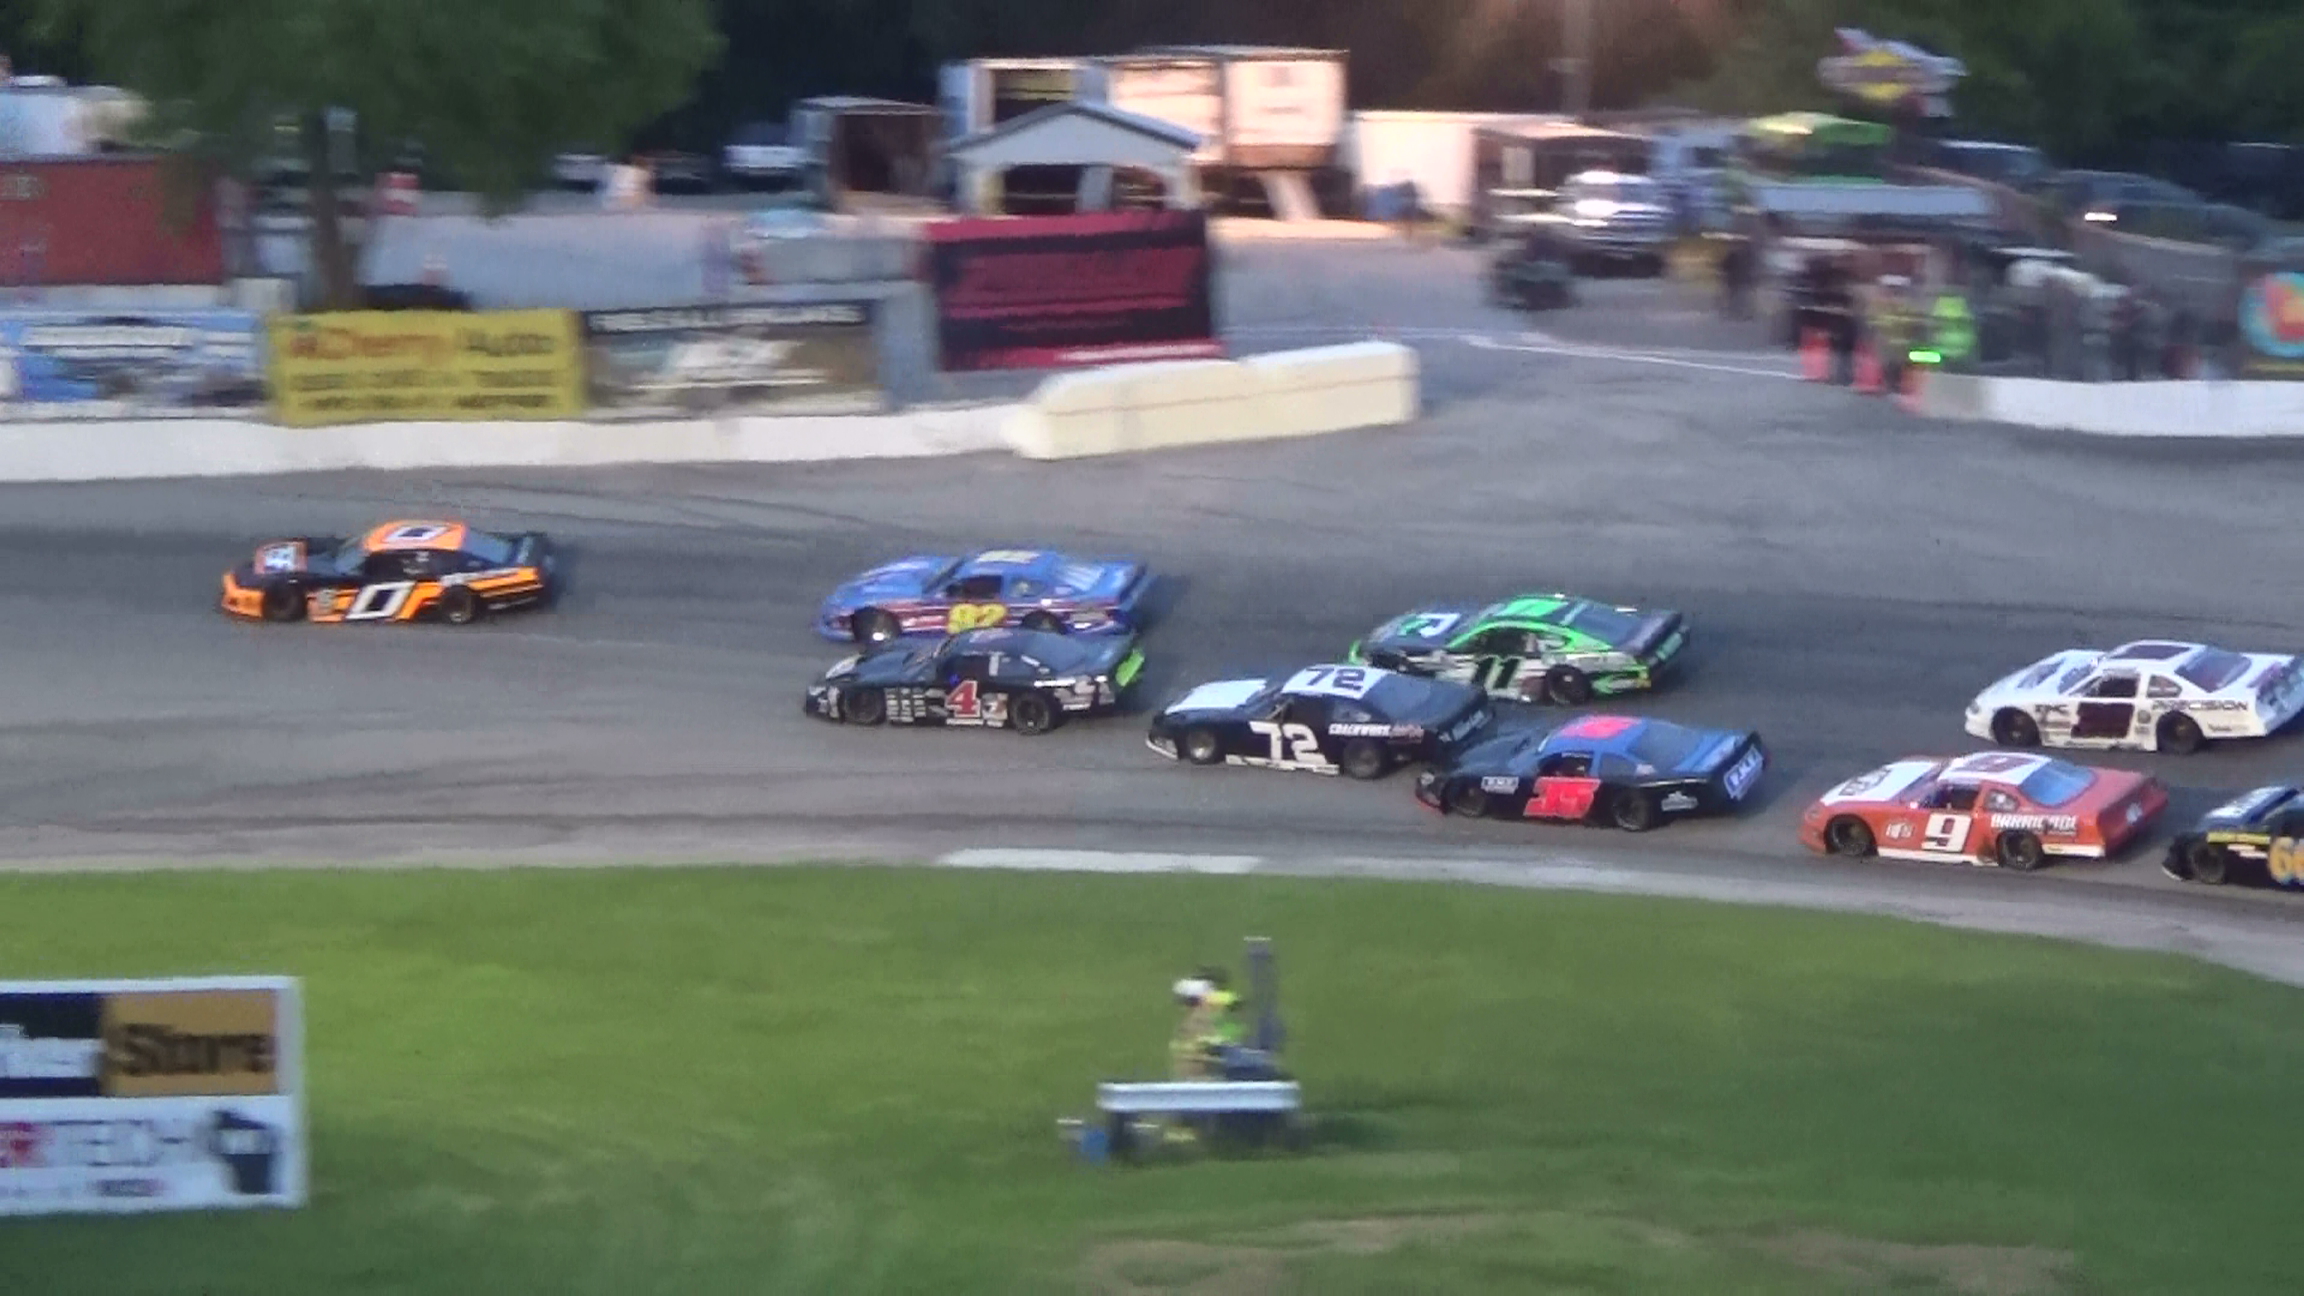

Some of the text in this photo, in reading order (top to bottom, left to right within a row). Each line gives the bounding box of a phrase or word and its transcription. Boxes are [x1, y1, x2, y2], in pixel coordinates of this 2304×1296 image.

[347, 581, 418, 620] 0
[1306, 667, 1366, 691] 72
[1471, 656, 1522, 690] 11
[945, 680, 981, 717] 4
[1250, 721, 1327, 764] 72
[1921, 813, 1972, 853] 9
[110, 1022, 276, 1077] Store
